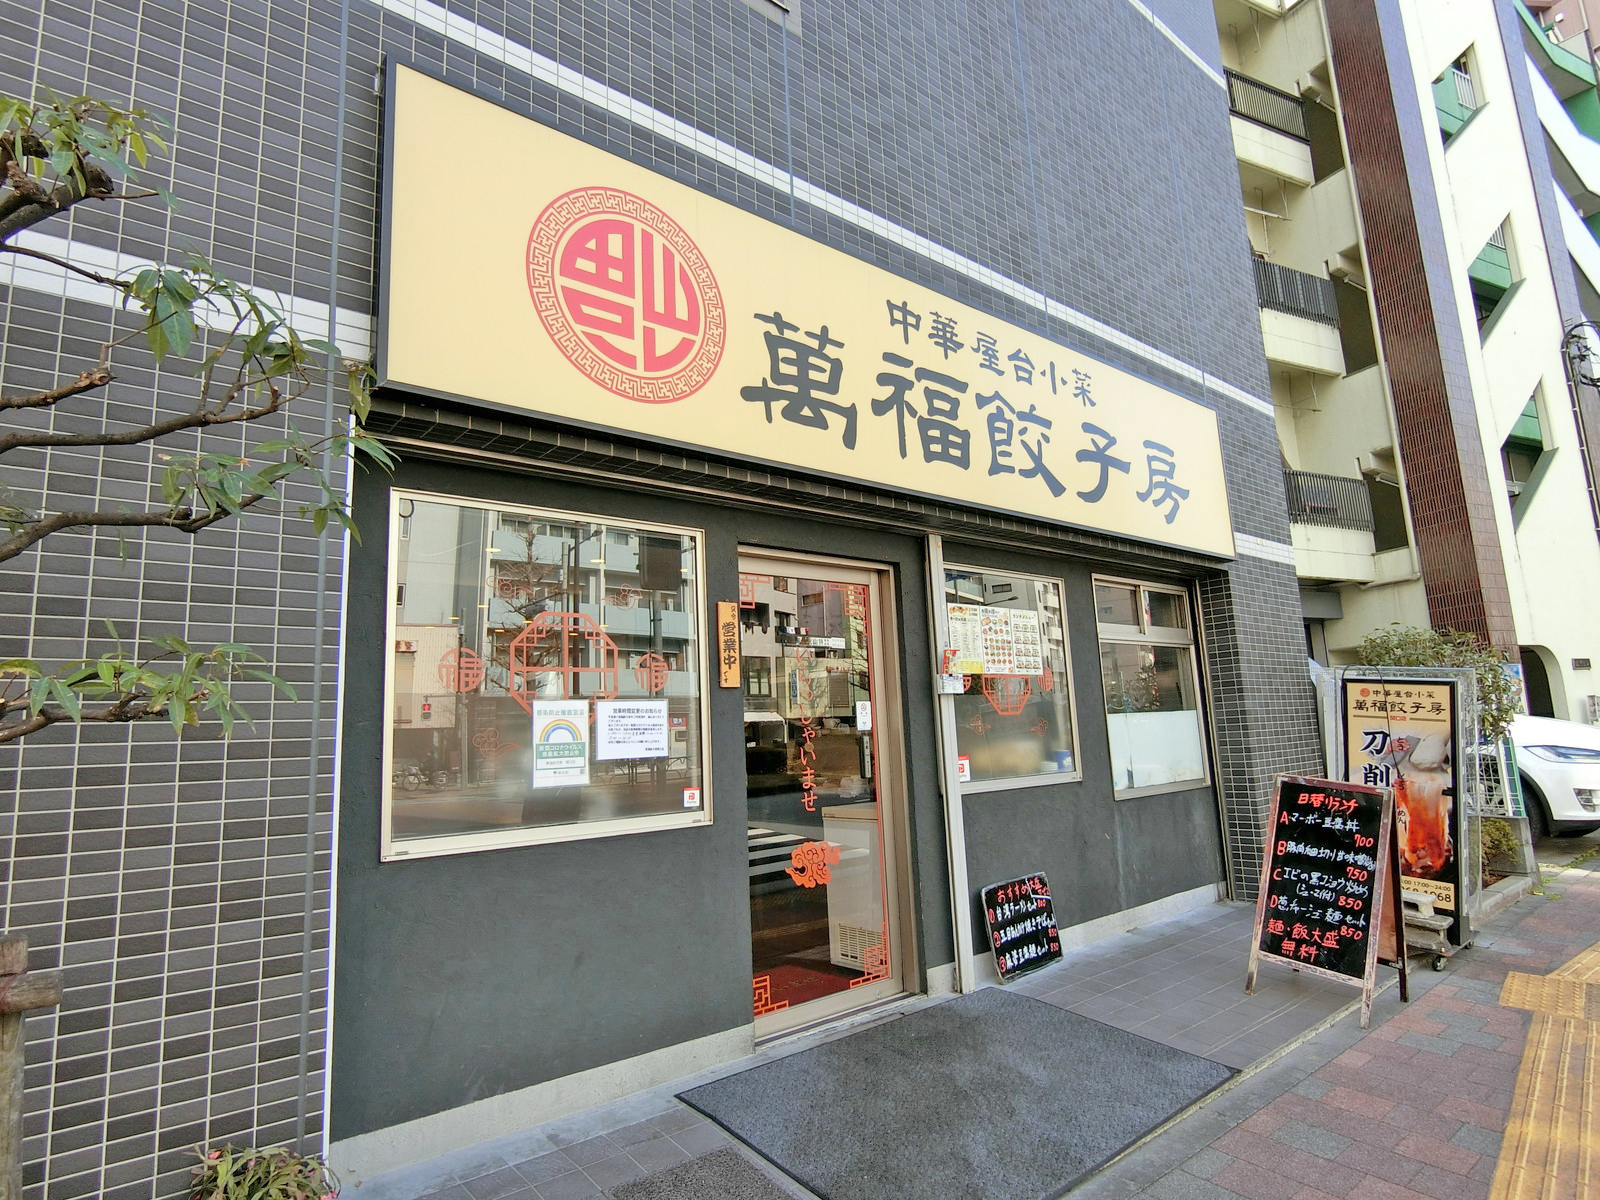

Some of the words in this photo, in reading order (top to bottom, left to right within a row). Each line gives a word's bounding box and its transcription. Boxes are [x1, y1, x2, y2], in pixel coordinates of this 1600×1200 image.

[886, 299, 1097, 408] 中華屋台小菜
[739, 311, 1190, 525] 萬福餃子房
[721, 621, 738, 670] 営業中
[1372, 689, 1435, 699] 中華屋台小菜
[1352, 699, 1447, 716] 萬福餃子房
[795, 647, 818, 812] いらっしゃいませ
[1297, 793, 1359, 815] 日替りランチ
[1279, 810, 1289, 825] A
[1276, 840, 1287, 856] B
[1354, 833, 1374, 848] 700
[1272, 868, 1283, 881] C
[1346, 866, 1368, 882] 750
[1269, 894, 1278, 909] D
[1337, 895, 1363, 910] 850
[1340, 925, 1363, 940] 850
[1281, 937, 1319, 962] 無料
